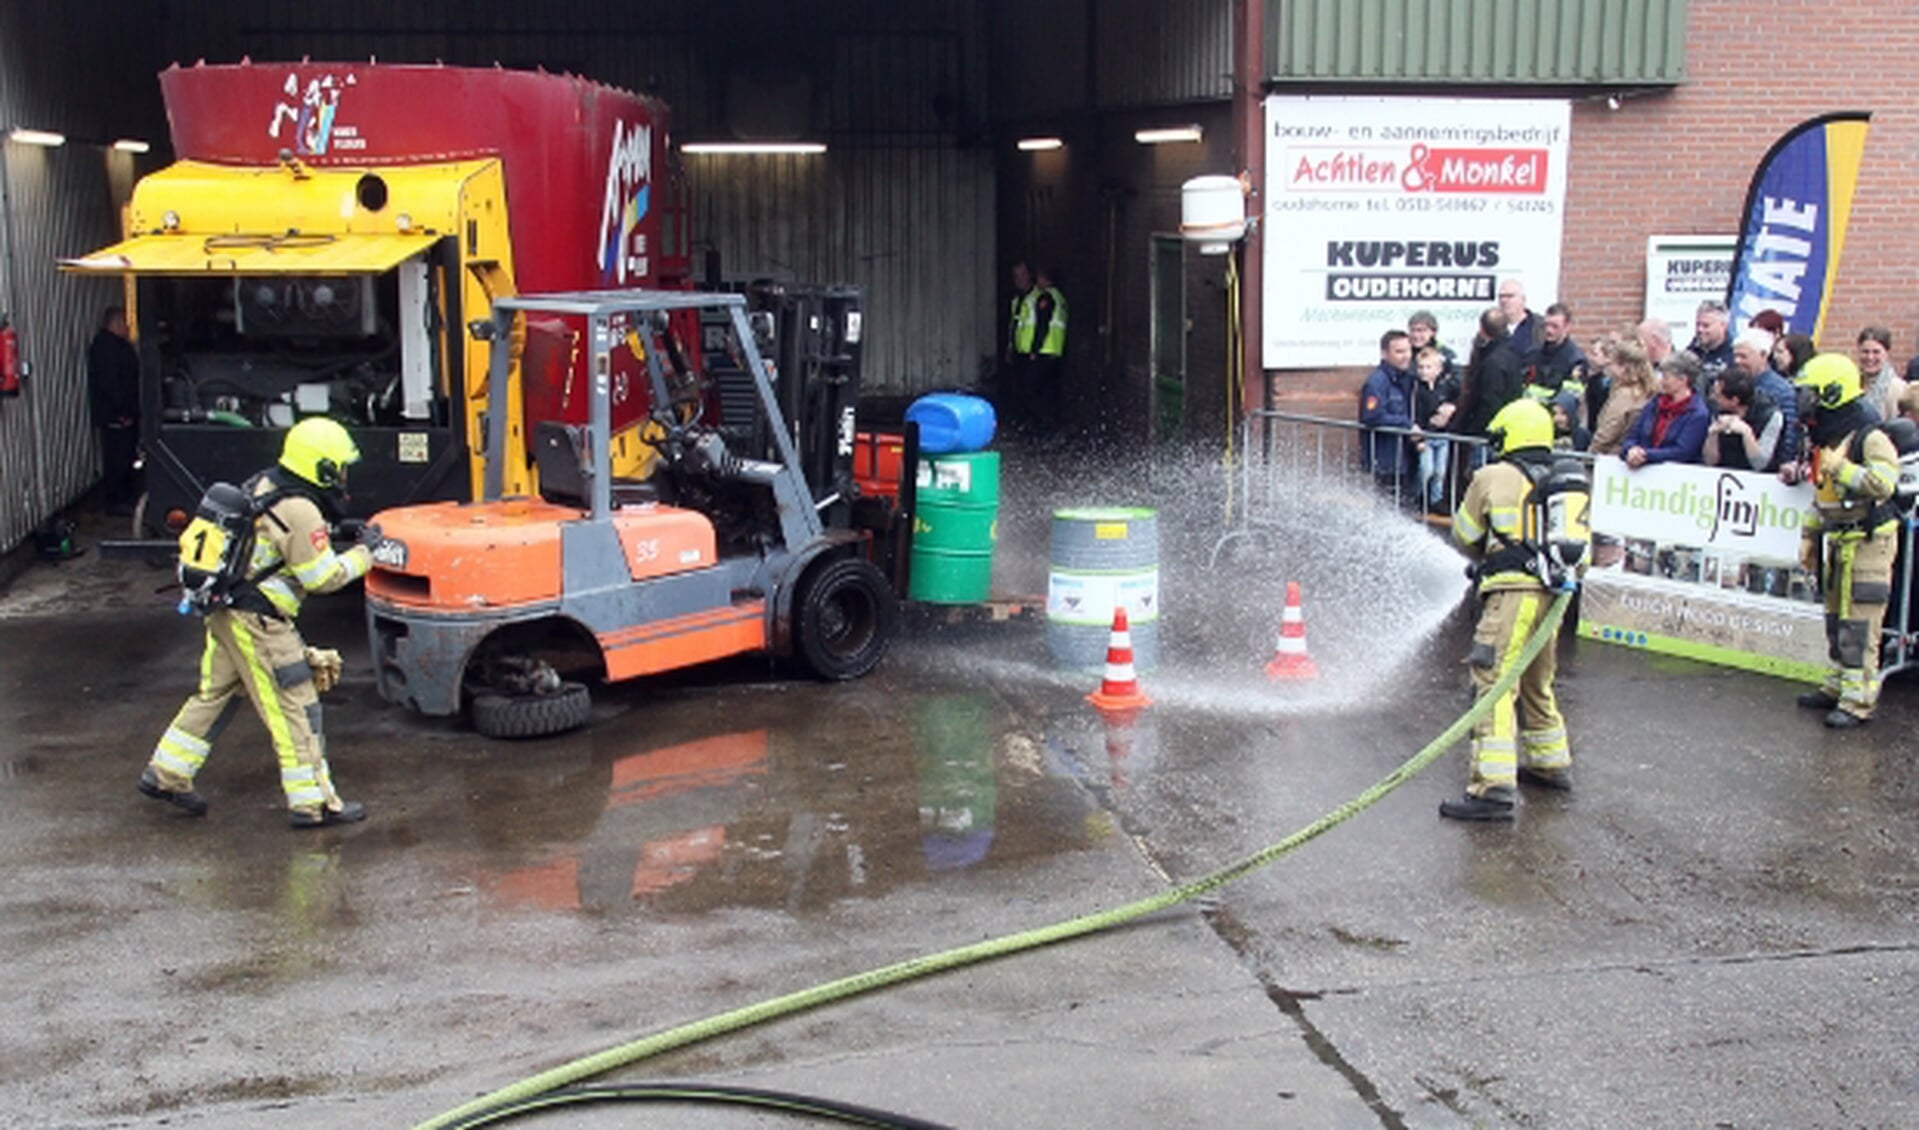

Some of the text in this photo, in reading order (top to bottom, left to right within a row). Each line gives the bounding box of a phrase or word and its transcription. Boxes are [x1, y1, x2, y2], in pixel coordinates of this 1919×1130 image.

[1348, 126, 1373, 140] en
[1380, 123, 1561, 147] aannemingsbedrijf
[1440, 153, 1538, 187] Monkel
[1326, 240, 1500, 268] KUPERUS
[1332, 277, 1492, 299] OUDEHORNE
[194, 529, 208, 562] 1
